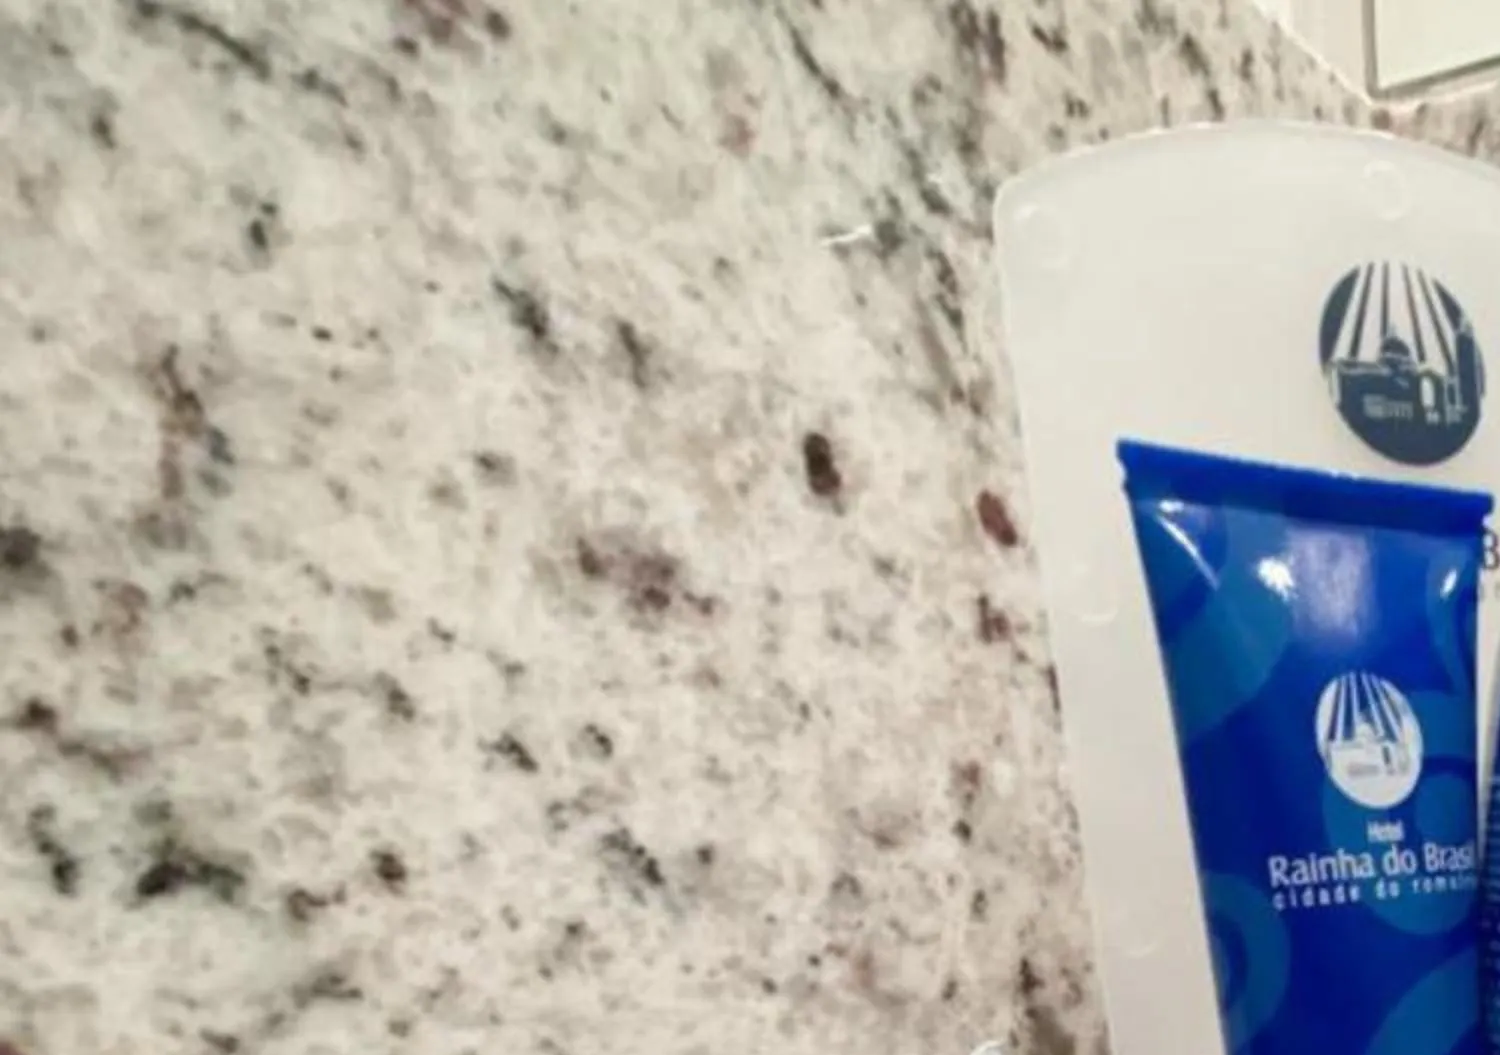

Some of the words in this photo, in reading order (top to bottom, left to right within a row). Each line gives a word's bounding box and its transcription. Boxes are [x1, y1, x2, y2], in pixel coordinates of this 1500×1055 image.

[1268, 847, 1375, 888] Rainha
[1382, 843, 1417, 876] do
[1272, 882, 1361, 911] cidade
[1375, 877, 1401, 899] do
